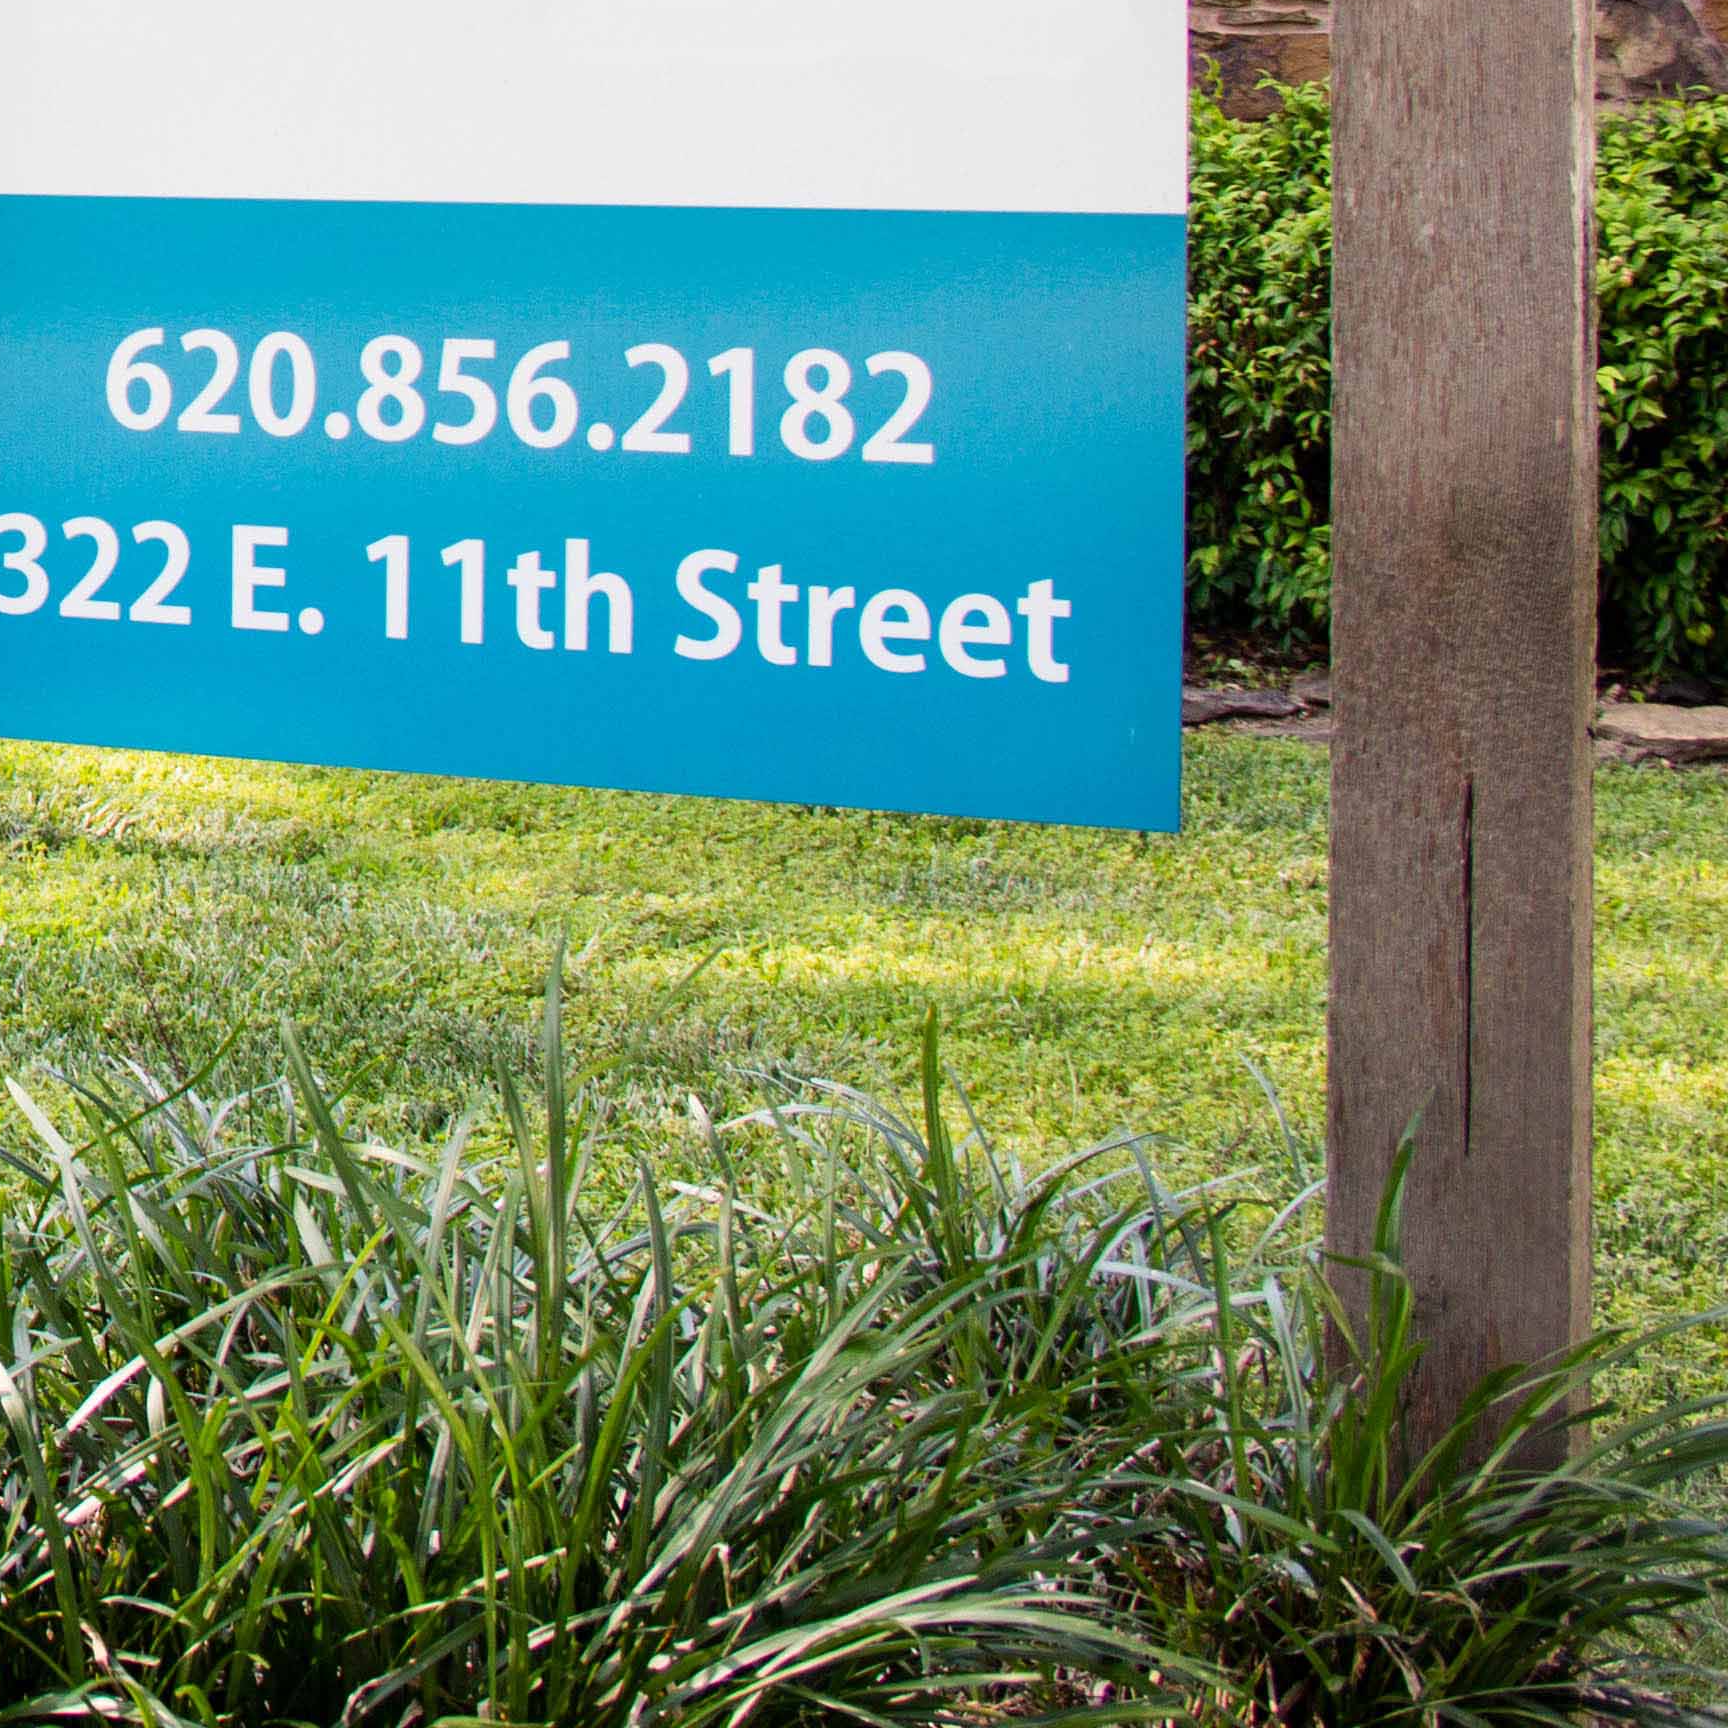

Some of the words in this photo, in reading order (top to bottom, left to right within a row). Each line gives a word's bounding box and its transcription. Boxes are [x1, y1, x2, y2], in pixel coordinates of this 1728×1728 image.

[106, 327, 935, 464] 620.856.2182
[232, 525, 324, 635] E.
[367, 535, 633, 654] 11th
[675, 549, 1072, 683] Street
